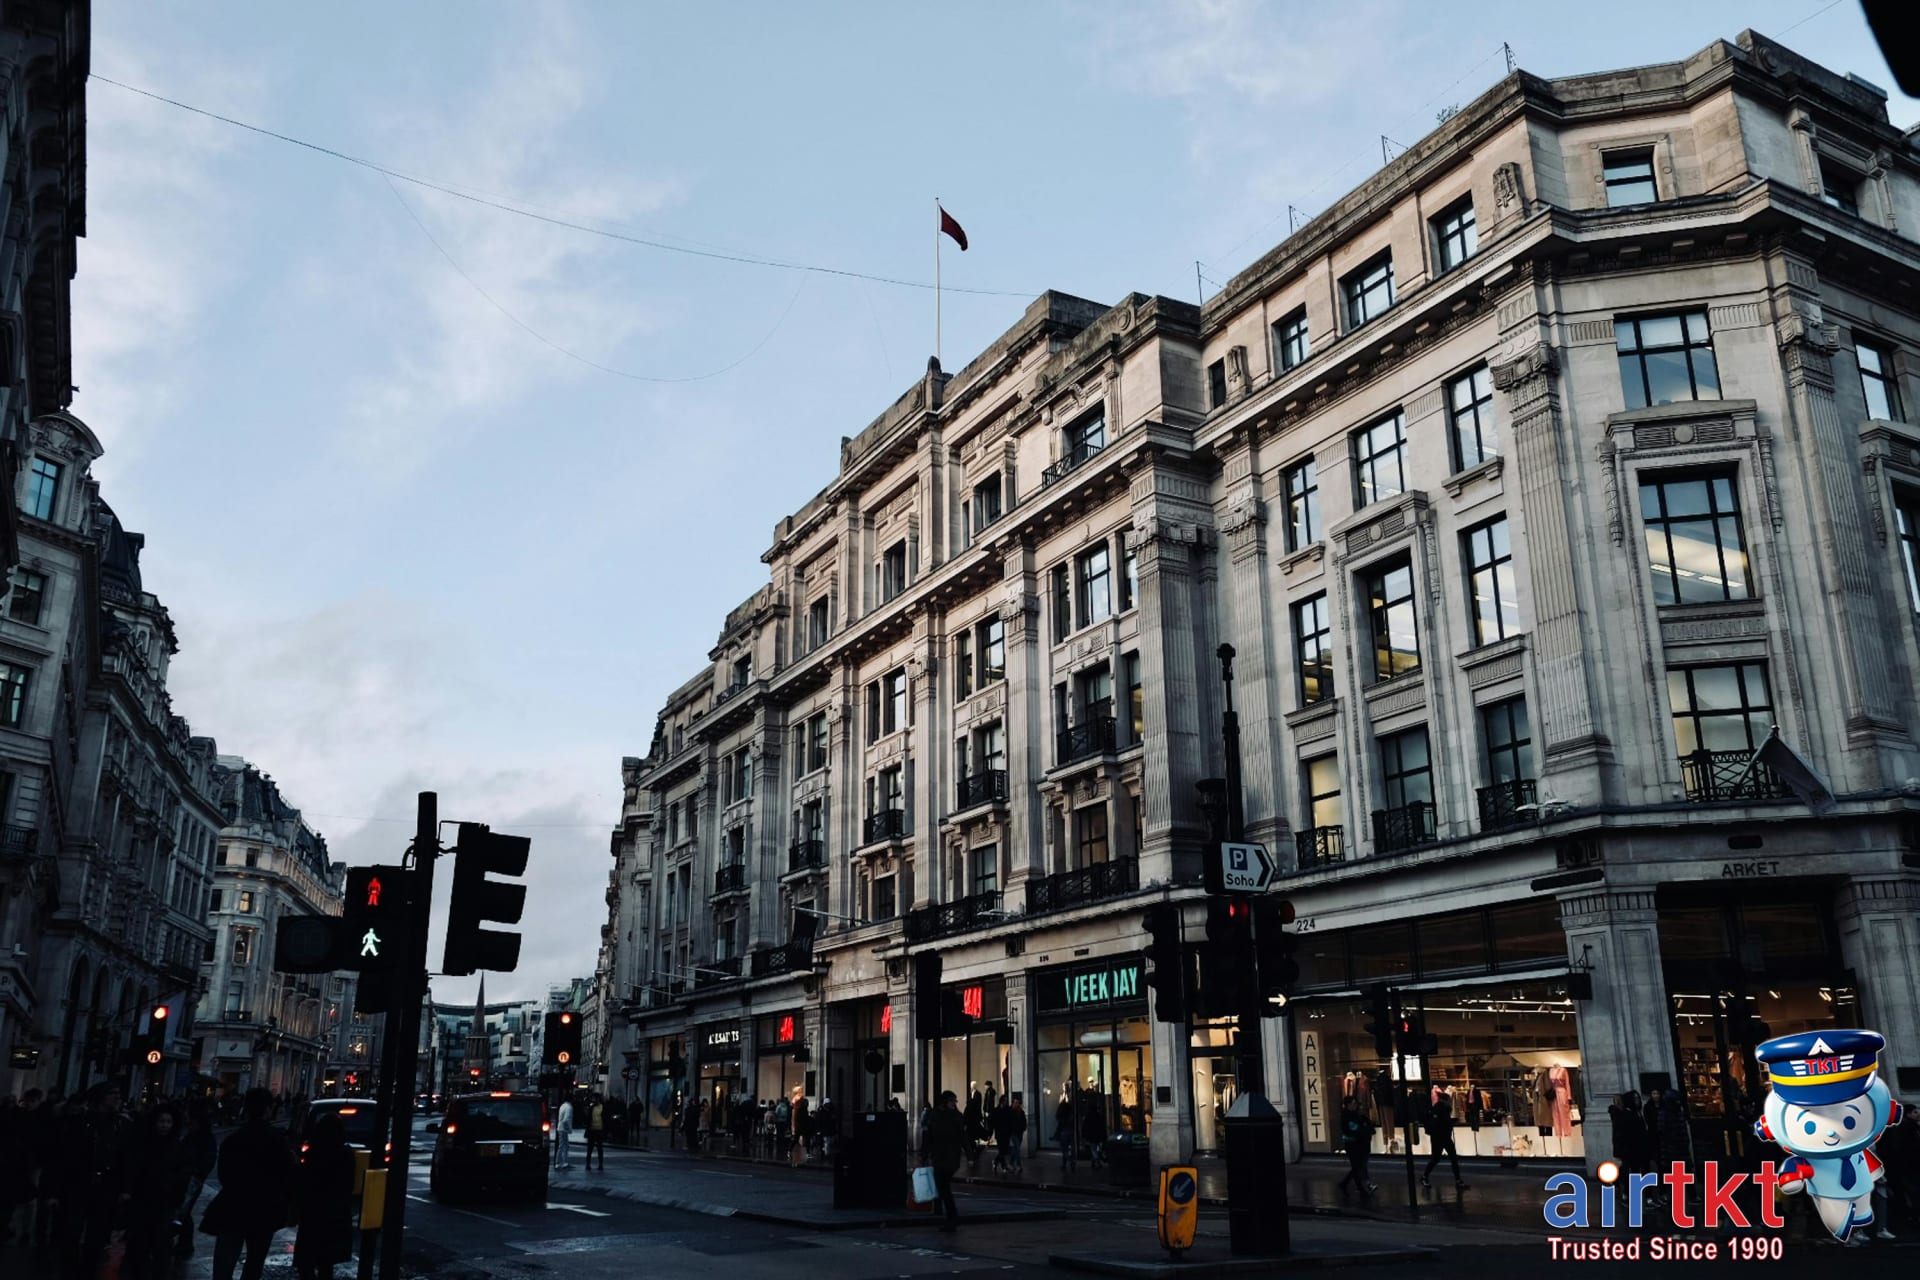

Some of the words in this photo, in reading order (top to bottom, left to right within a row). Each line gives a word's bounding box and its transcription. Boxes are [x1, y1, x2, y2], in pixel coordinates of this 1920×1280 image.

[1232, 849, 1245, 868] P
[1722, 861, 1779, 877] ARKET
[1226, 873, 1255, 887] Soho
[1296, 918, 1316, 932] 224
[1305, 1034, 1322, 1139] ARKET
